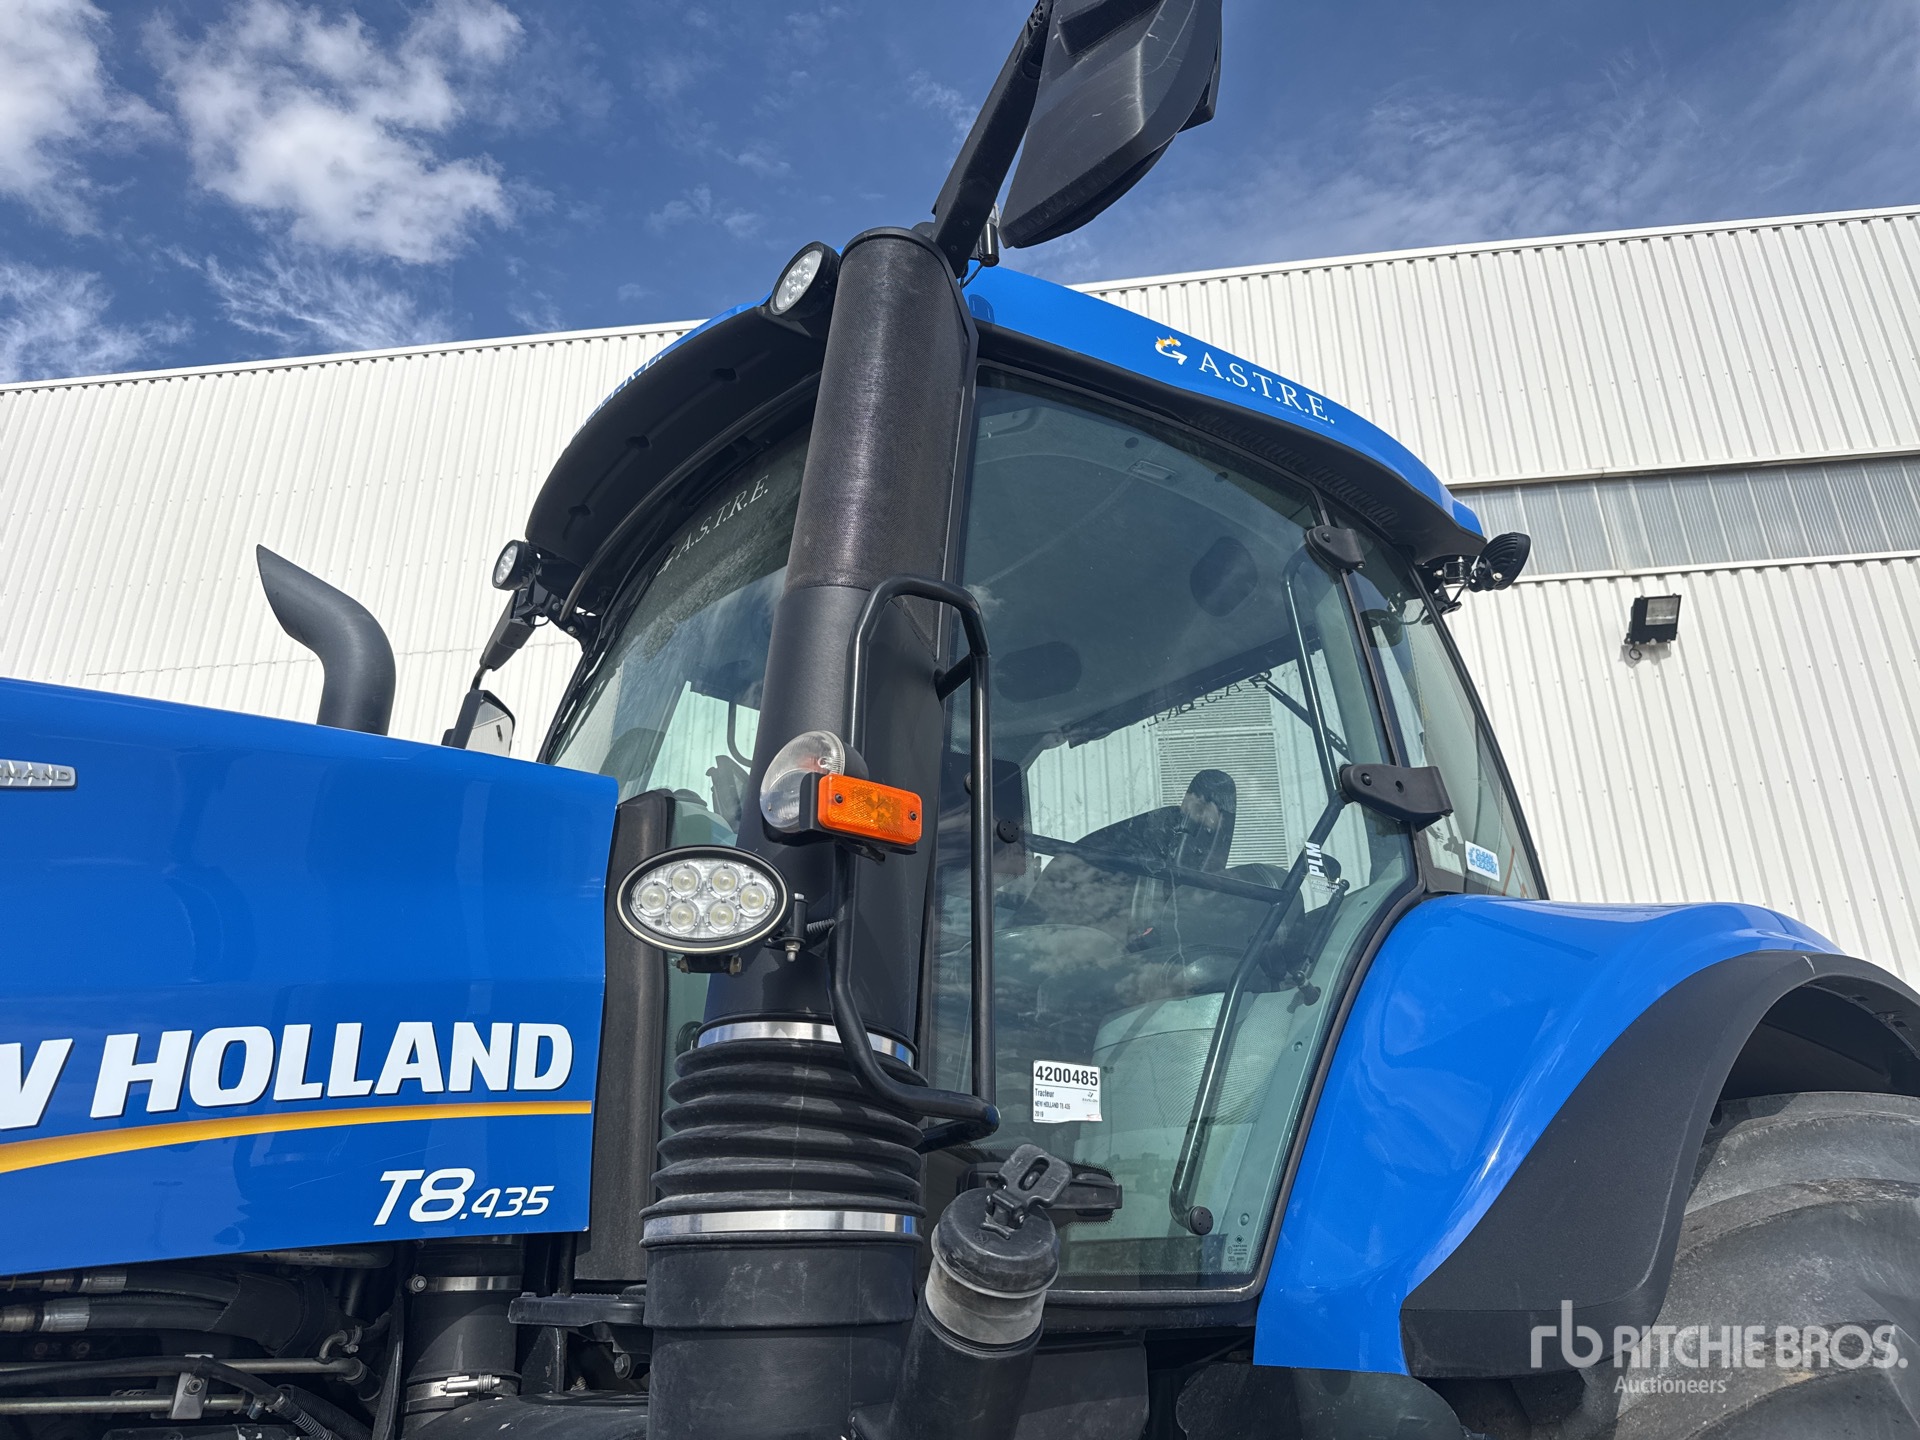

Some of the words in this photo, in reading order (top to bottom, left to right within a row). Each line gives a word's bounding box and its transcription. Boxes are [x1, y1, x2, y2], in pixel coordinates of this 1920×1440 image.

[1198, 352, 1335, 425] A.S.T.R.E.
[0, 767, 72, 782] MAND
[1304, 841, 1326, 878] PLM
[90, 1021, 575, 1119] HOLLAND
[1035, 1066, 1098, 1086] 4200485
[373, 1167, 556, 1227] T8.435
